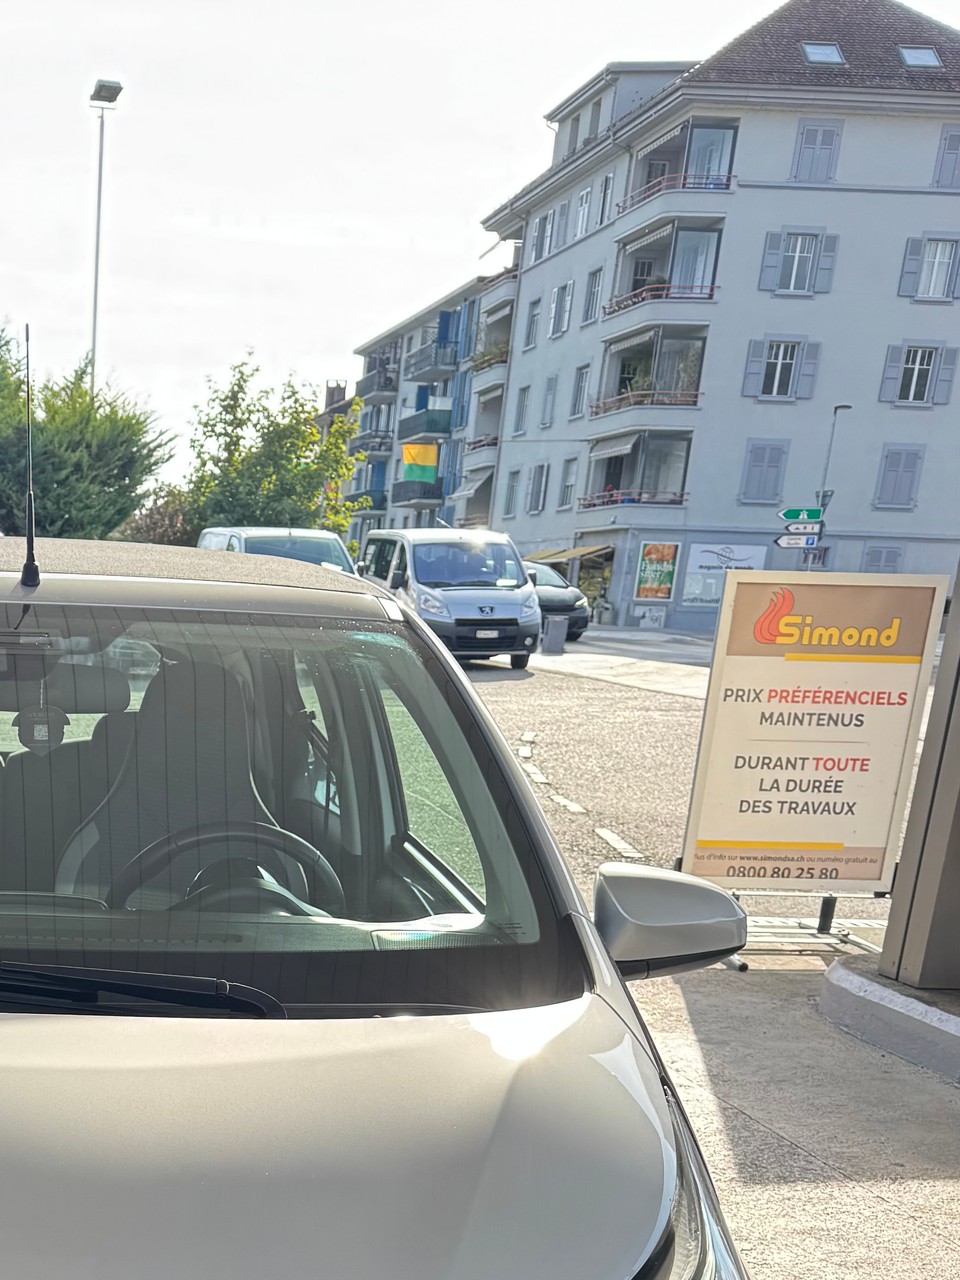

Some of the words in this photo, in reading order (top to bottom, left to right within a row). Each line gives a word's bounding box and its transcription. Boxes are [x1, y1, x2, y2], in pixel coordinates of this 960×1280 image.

[775, 615, 901, 647] Simond
[723, 688, 764, 703] PRIX
[767, 686, 908, 706] PRÉFÉRENCIELS
[759, 712, 865, 728] MAINTENUS
[734, 755, 810, 772] DURANT
[812, 757, 870, 772] TOUTE
[758, 778, 780, 793] LA
[785, 776, 844, 794] DURÉE
[738, 799, 772, 814] DES
[777, 800, 857, 816] TRAVAUX
[739, 854, 805, 862] www.simondsa.ch
[816, 855, 844, 863] numéro
[844, 856, 868, 865] gratuit
[726, 865, 767, 878] 0800
[770, 866, 791, 878] 80
[795, 866, 814, 879] 25
[818, 867, 839, 879] 80
